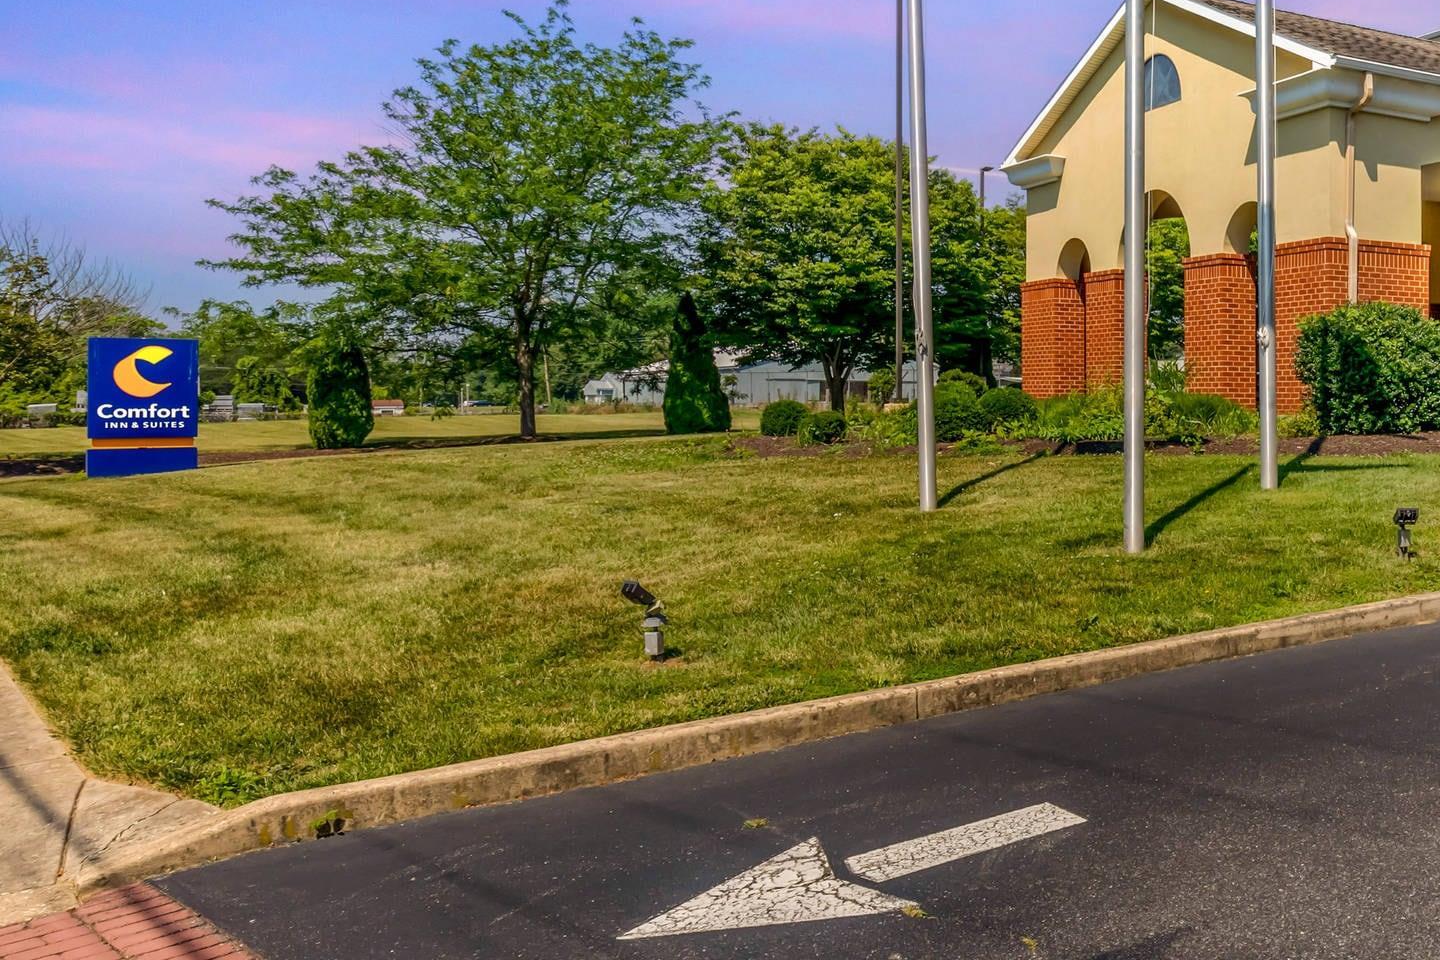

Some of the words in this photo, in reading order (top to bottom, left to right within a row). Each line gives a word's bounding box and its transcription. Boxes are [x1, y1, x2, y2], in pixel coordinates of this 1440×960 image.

[96, 403, 191, 419] Comfort
[104, 421, 129, 429] INN
[131, 421, 140, 429] &
[142, 421, 185, 429] SUITES
